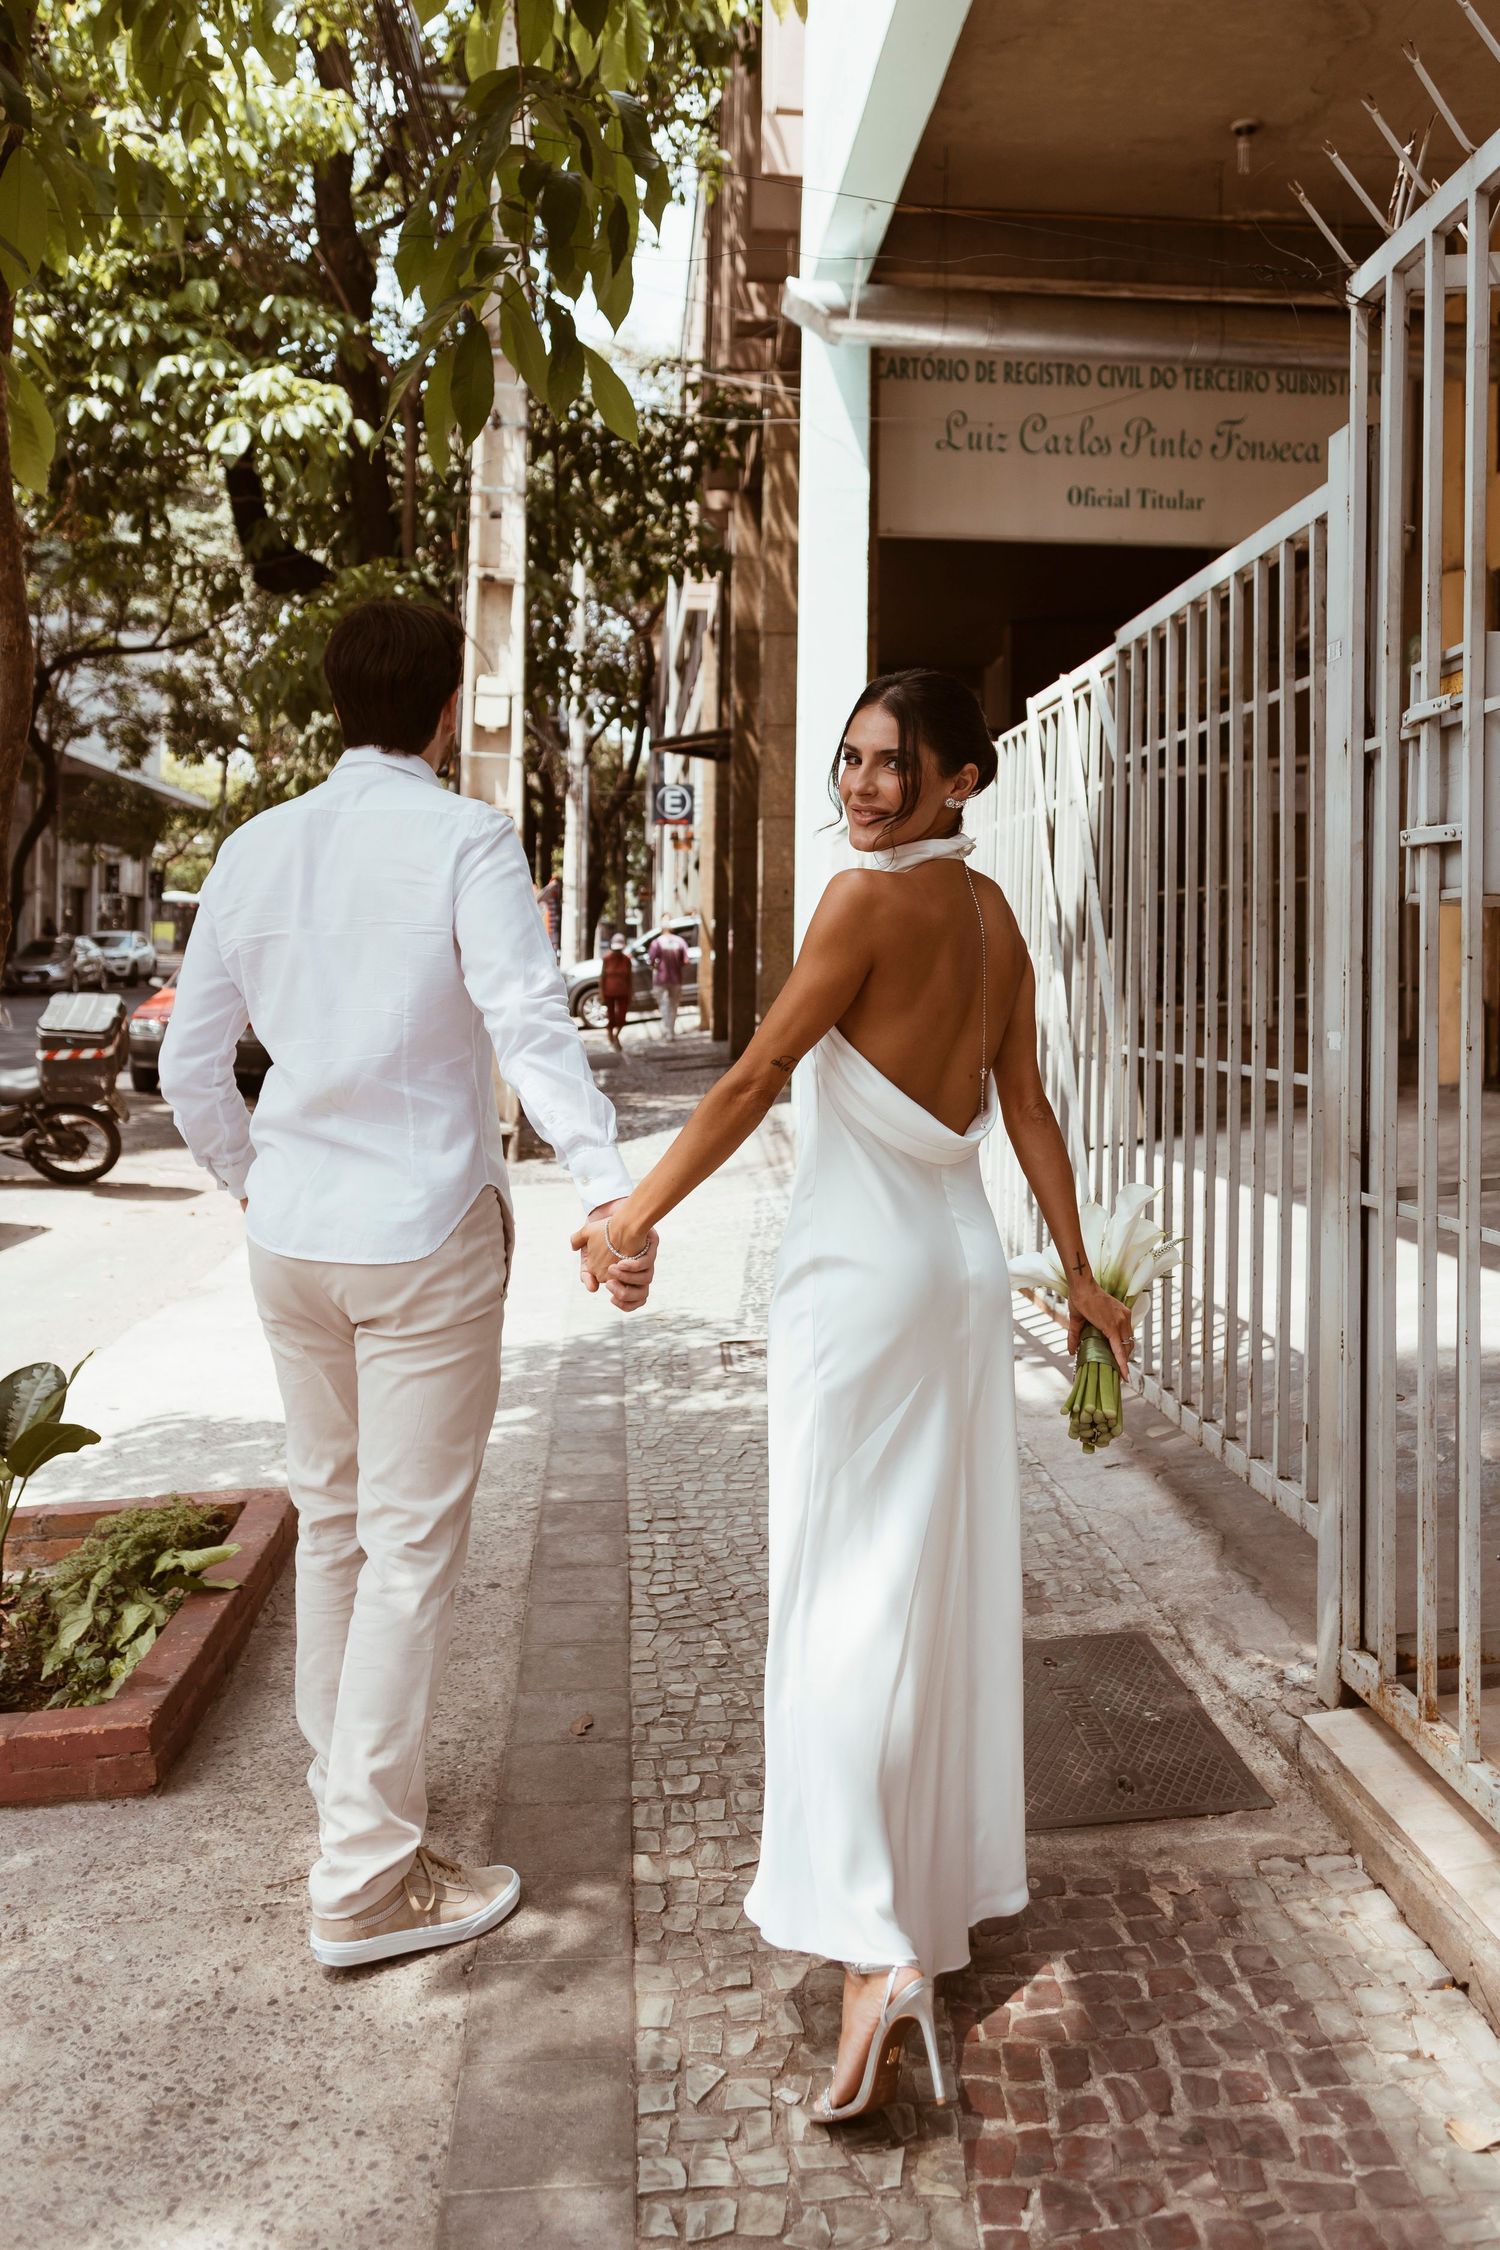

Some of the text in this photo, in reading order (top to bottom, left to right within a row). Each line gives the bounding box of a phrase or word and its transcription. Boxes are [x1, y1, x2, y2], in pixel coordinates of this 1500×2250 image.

[976, 360, 997, 382] DE
[1003, 361, 1092, 387] REGISTRO
[1097, 364, 1143, 388] CIVIL
[1151, 366, 1177, 389] DO
[1184, 367, 1270, 393] TERCEIRO
[935, 409, 1320, 463] Luiz Carlos Pinto Fonseca
[1067, 485, 1205, 511] Oficial Titular
[664, 789, 682, 814] E
